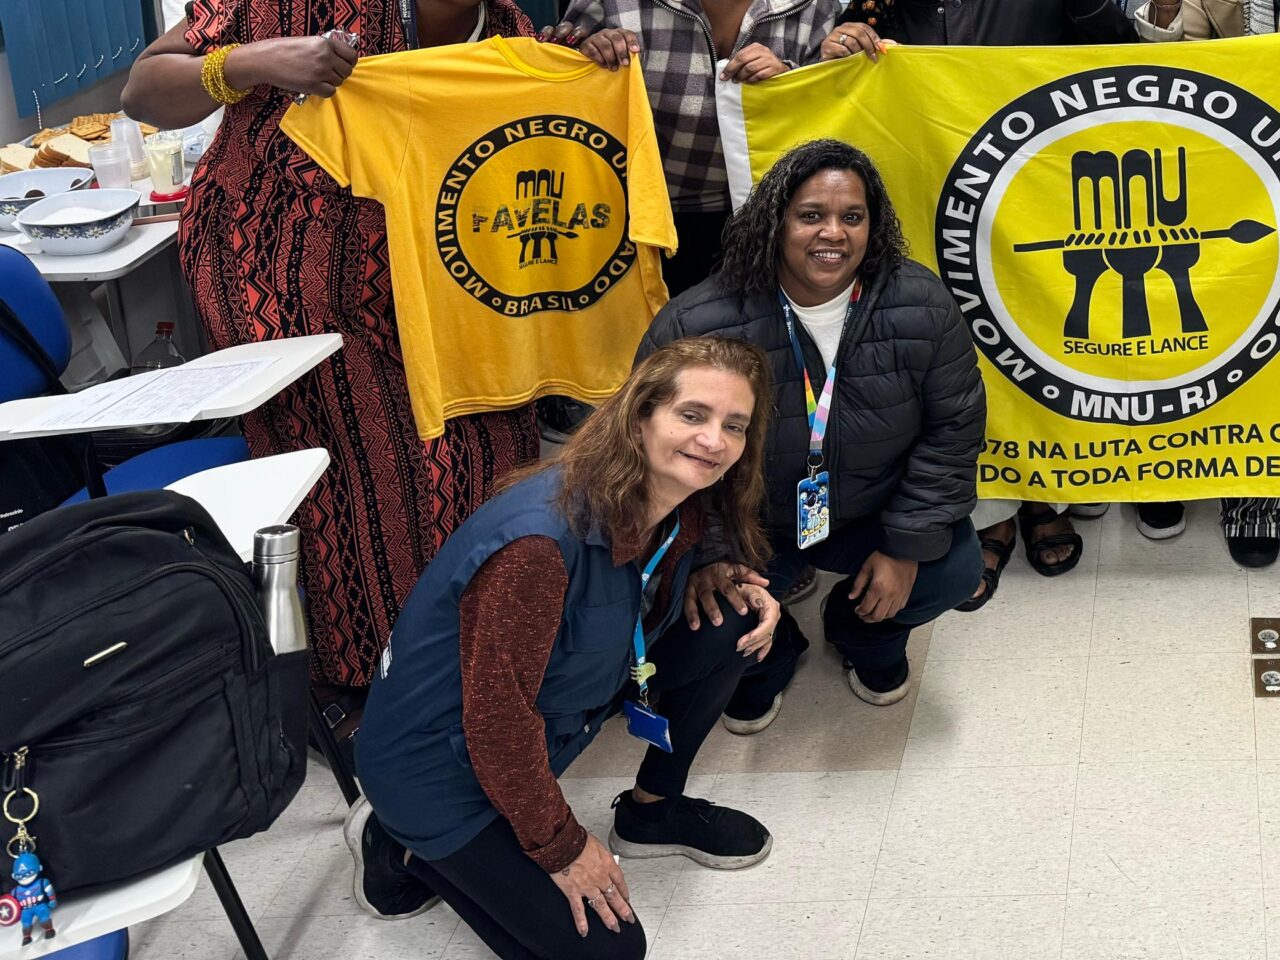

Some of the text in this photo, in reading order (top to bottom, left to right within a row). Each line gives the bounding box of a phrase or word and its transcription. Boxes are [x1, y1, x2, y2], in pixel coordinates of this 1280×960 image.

[437, 140, 495, 298] MOVIMENTO
[504, 119, 608, 150] NEGRO
[472, 198, 611, 233] FAVELAS
[943, 111, 1036, 382] MOVIMENTO
[1051, 74, 1237, 120] NEGRO
[504, 294, 580, 315] BRASIL
[1063, 335, 1209, 356] SEGURE E LANCE
[1070, 385, 1218, 422] MNU RJ
[1029, 440, 1067, 460] NA
[1074, 437, 1143, 460] LUTA
[1148, 423, 1259, 451] CONTRA
[1028, 471, 1047, 488] A
[1050, 465, 1128, 489] TODA
[1137, 457, 1237, 482] FORMA
[1246, 456, 1280, 478] DE
